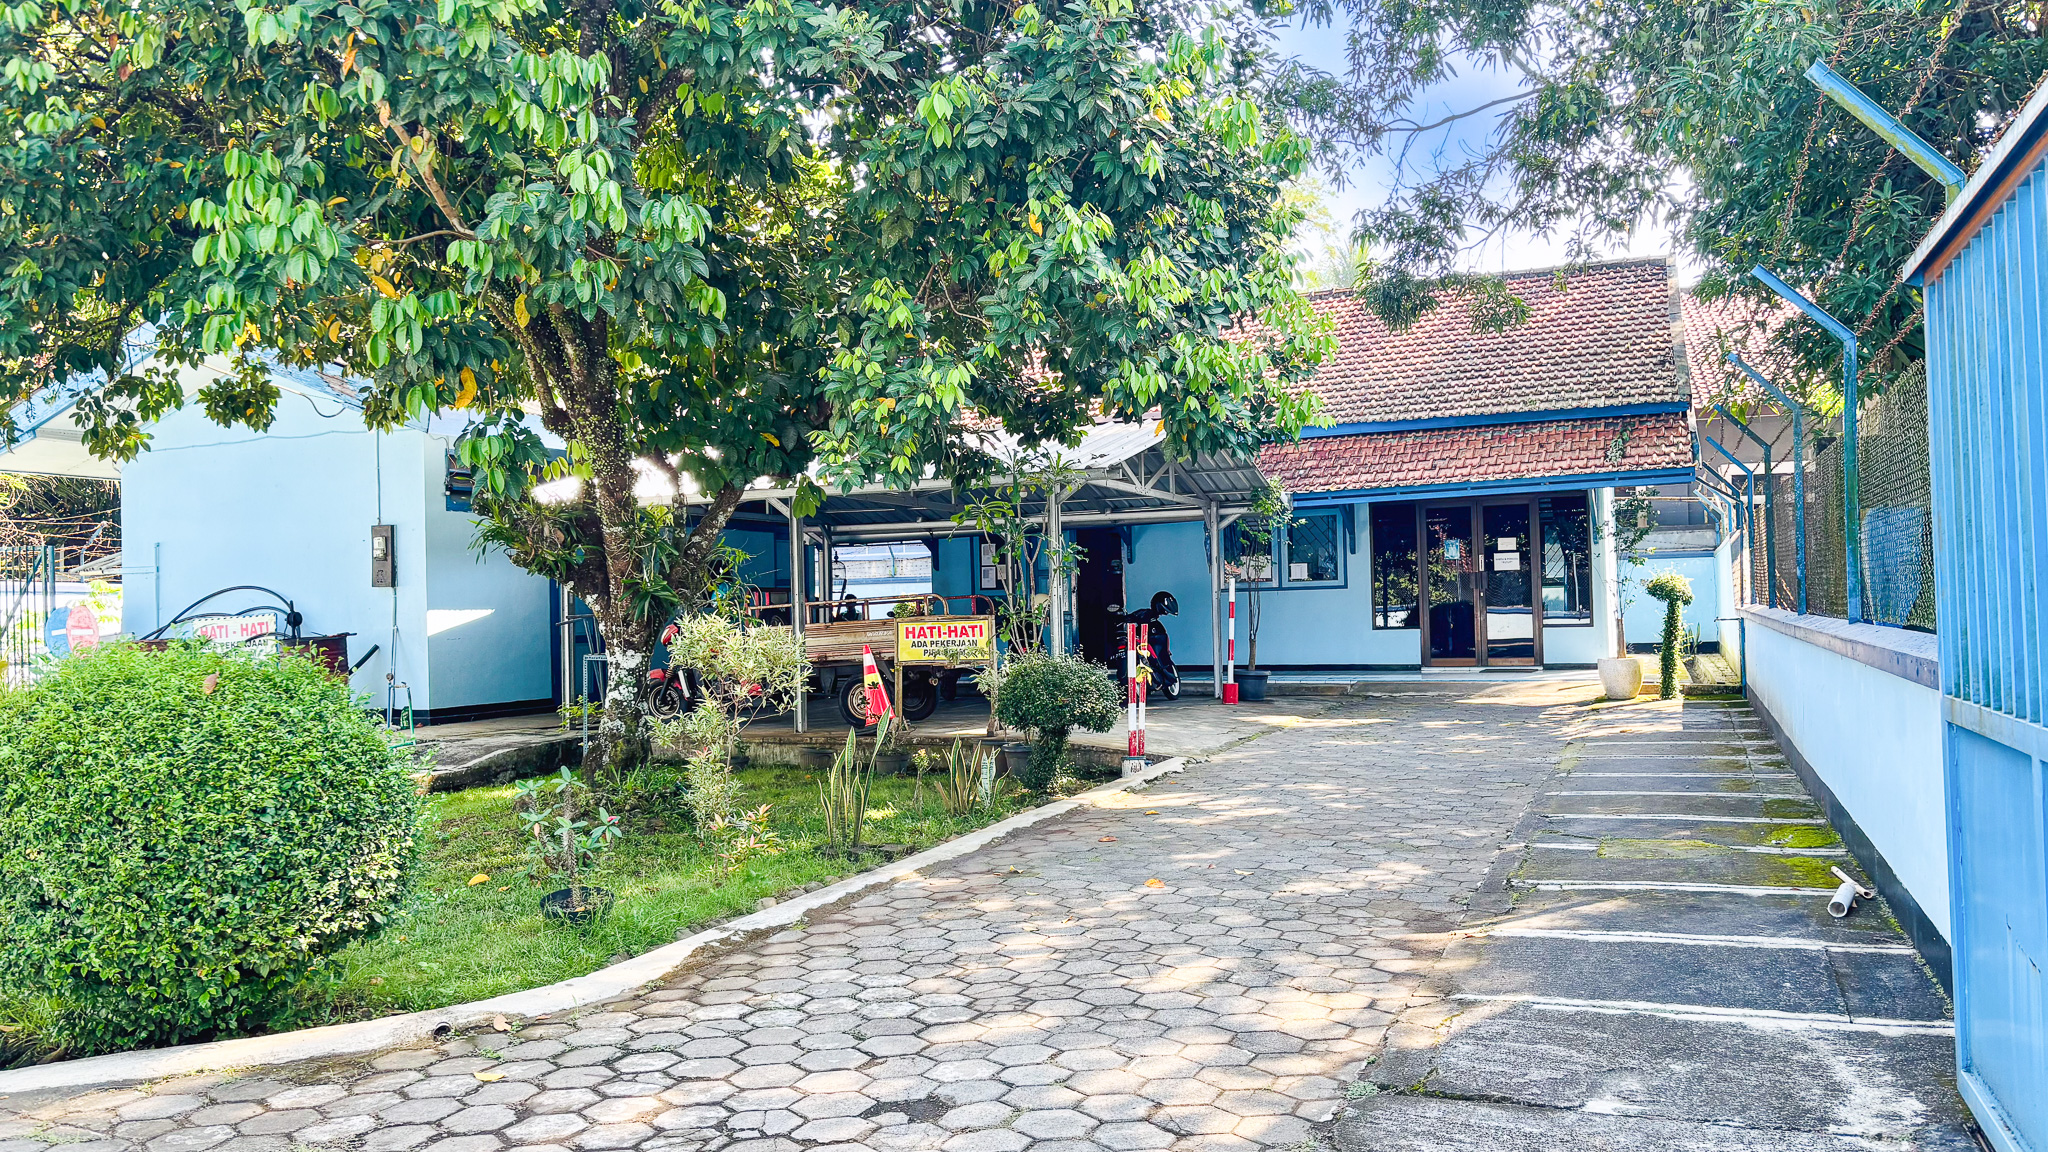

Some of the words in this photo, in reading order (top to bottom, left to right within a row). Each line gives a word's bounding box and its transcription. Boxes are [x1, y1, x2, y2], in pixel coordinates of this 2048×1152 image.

[200, 625, 229, 639] HATI
[240, 621, 269, 637] HATI
[905, 625, 984, 639] HATI-HATI
[911, 641, 928, 649] ADA
[930, 639, 978, 649] PEKERJAAN
